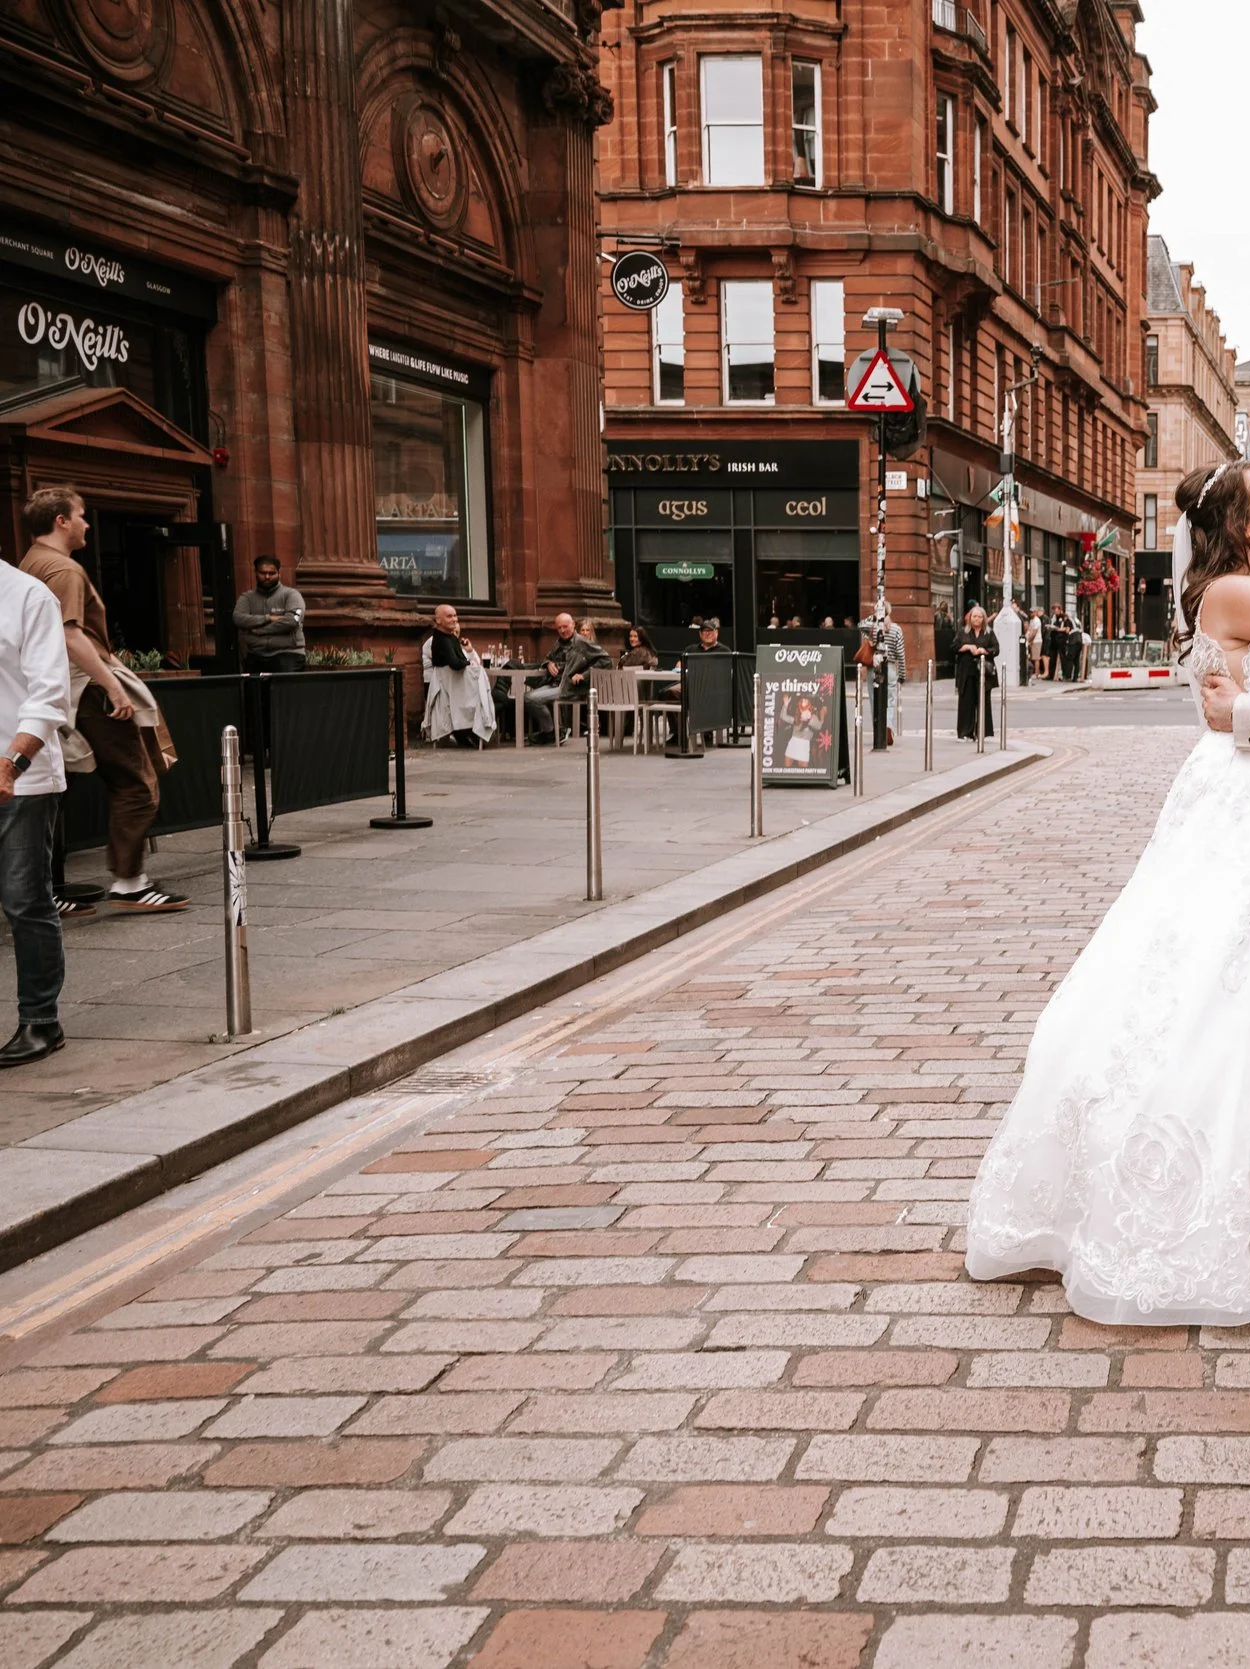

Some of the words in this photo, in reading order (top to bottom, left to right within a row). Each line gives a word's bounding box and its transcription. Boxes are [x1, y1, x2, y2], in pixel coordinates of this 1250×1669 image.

[31, 245, 54, 260] SQUARE
[65, 247, 126, 287] O'Neill's
[146, 280, 171, 295] GLASGOW
[617, 265, 663, 293] O'Neill's
[18, 302, 130, 371] O'Neill's
[368, 344, 390, 361] WHERE
[427, 362, 441, 376] FLOW
[441, 366, 453, 380] LIKE
[453, 370, 469, 385] MUSIC
[607, 454, 721, 472] NNOLLY'S
[728, 462, 756, 473] IRISH
[759, 462, 779, 473] BAR
[658, 500, 708, 520] agus
[786, 497, 826, 516] ceol
[775, 649, 822, 667] O'Neill's
[765, 681, 779, 694] ye
[781, 679, 820, 695] thirsty
[765, 692, 776, 716] ALL
[763, 718, 775, 755] COME
